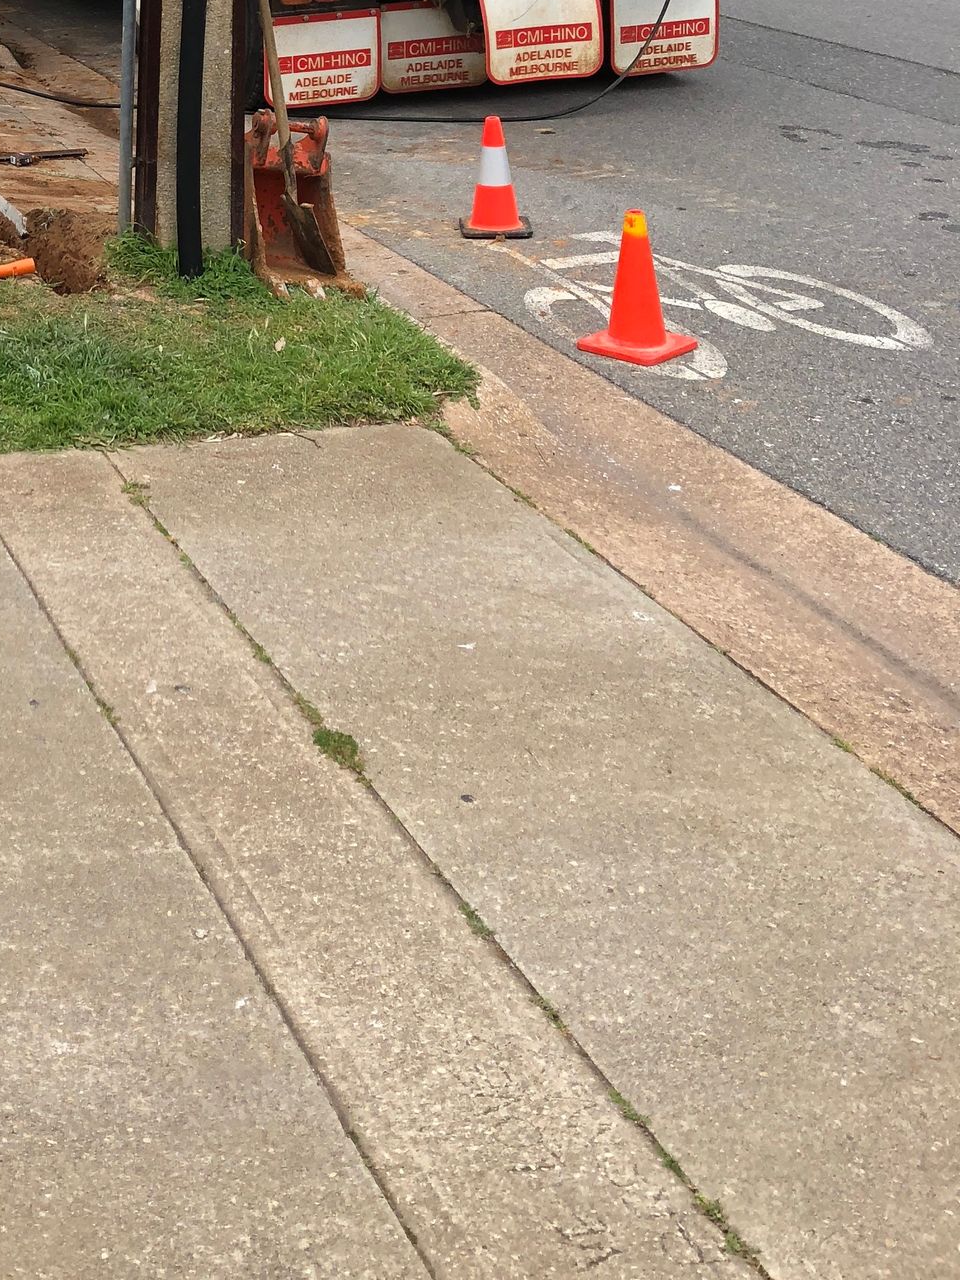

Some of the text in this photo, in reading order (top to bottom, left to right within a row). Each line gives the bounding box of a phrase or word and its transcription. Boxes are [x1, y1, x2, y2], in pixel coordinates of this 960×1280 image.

[517, 26, 588, 45] CMI-HINO
[297, 52, 367, 70] CMI-HINO
[515, 48, 572, 63] ADELAIDE
[406, 58, 463, 73] ADELAIDE
[509, 61, 578, 77] MELBOURNE
[295, 73, 352, 88] ADELAIDE
[400, 70, 469, 86] MELBOURNE
[289, 85, 358, 101] MELBOURNE
